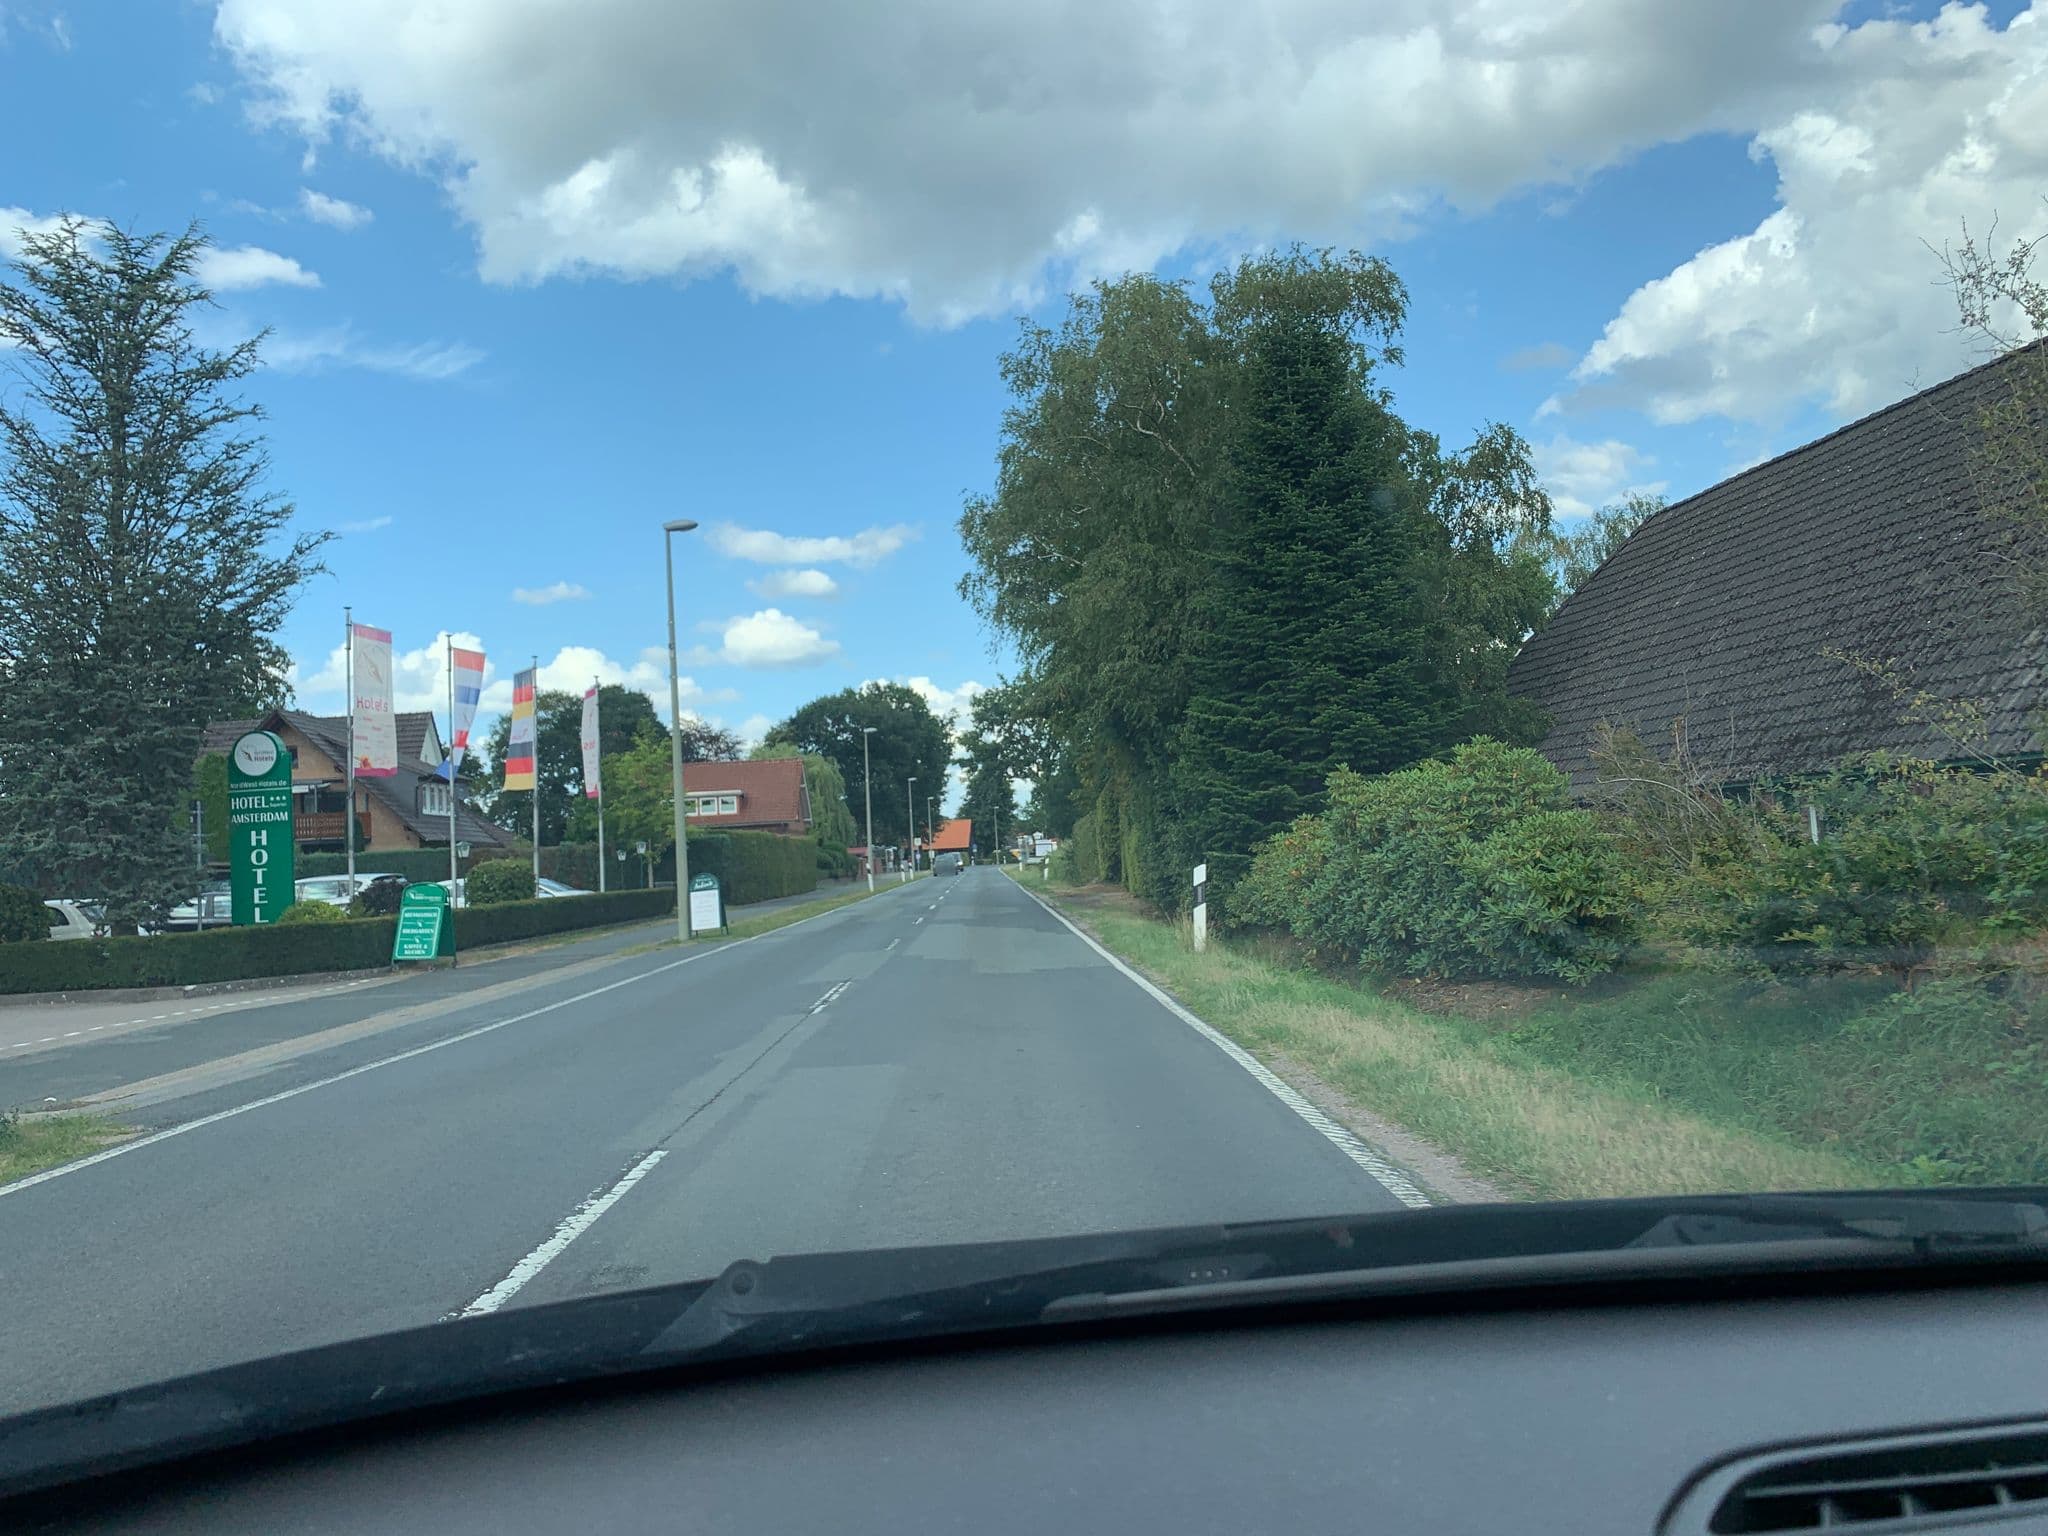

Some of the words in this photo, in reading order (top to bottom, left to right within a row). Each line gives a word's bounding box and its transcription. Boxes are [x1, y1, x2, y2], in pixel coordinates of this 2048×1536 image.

[357, 696, 388, 712] Hotels
[231, 796, 269, 809] HOTEL
[231, 812, 287, 823] AMSTERDAM
[251, 830, 268, 923] HOTEL
